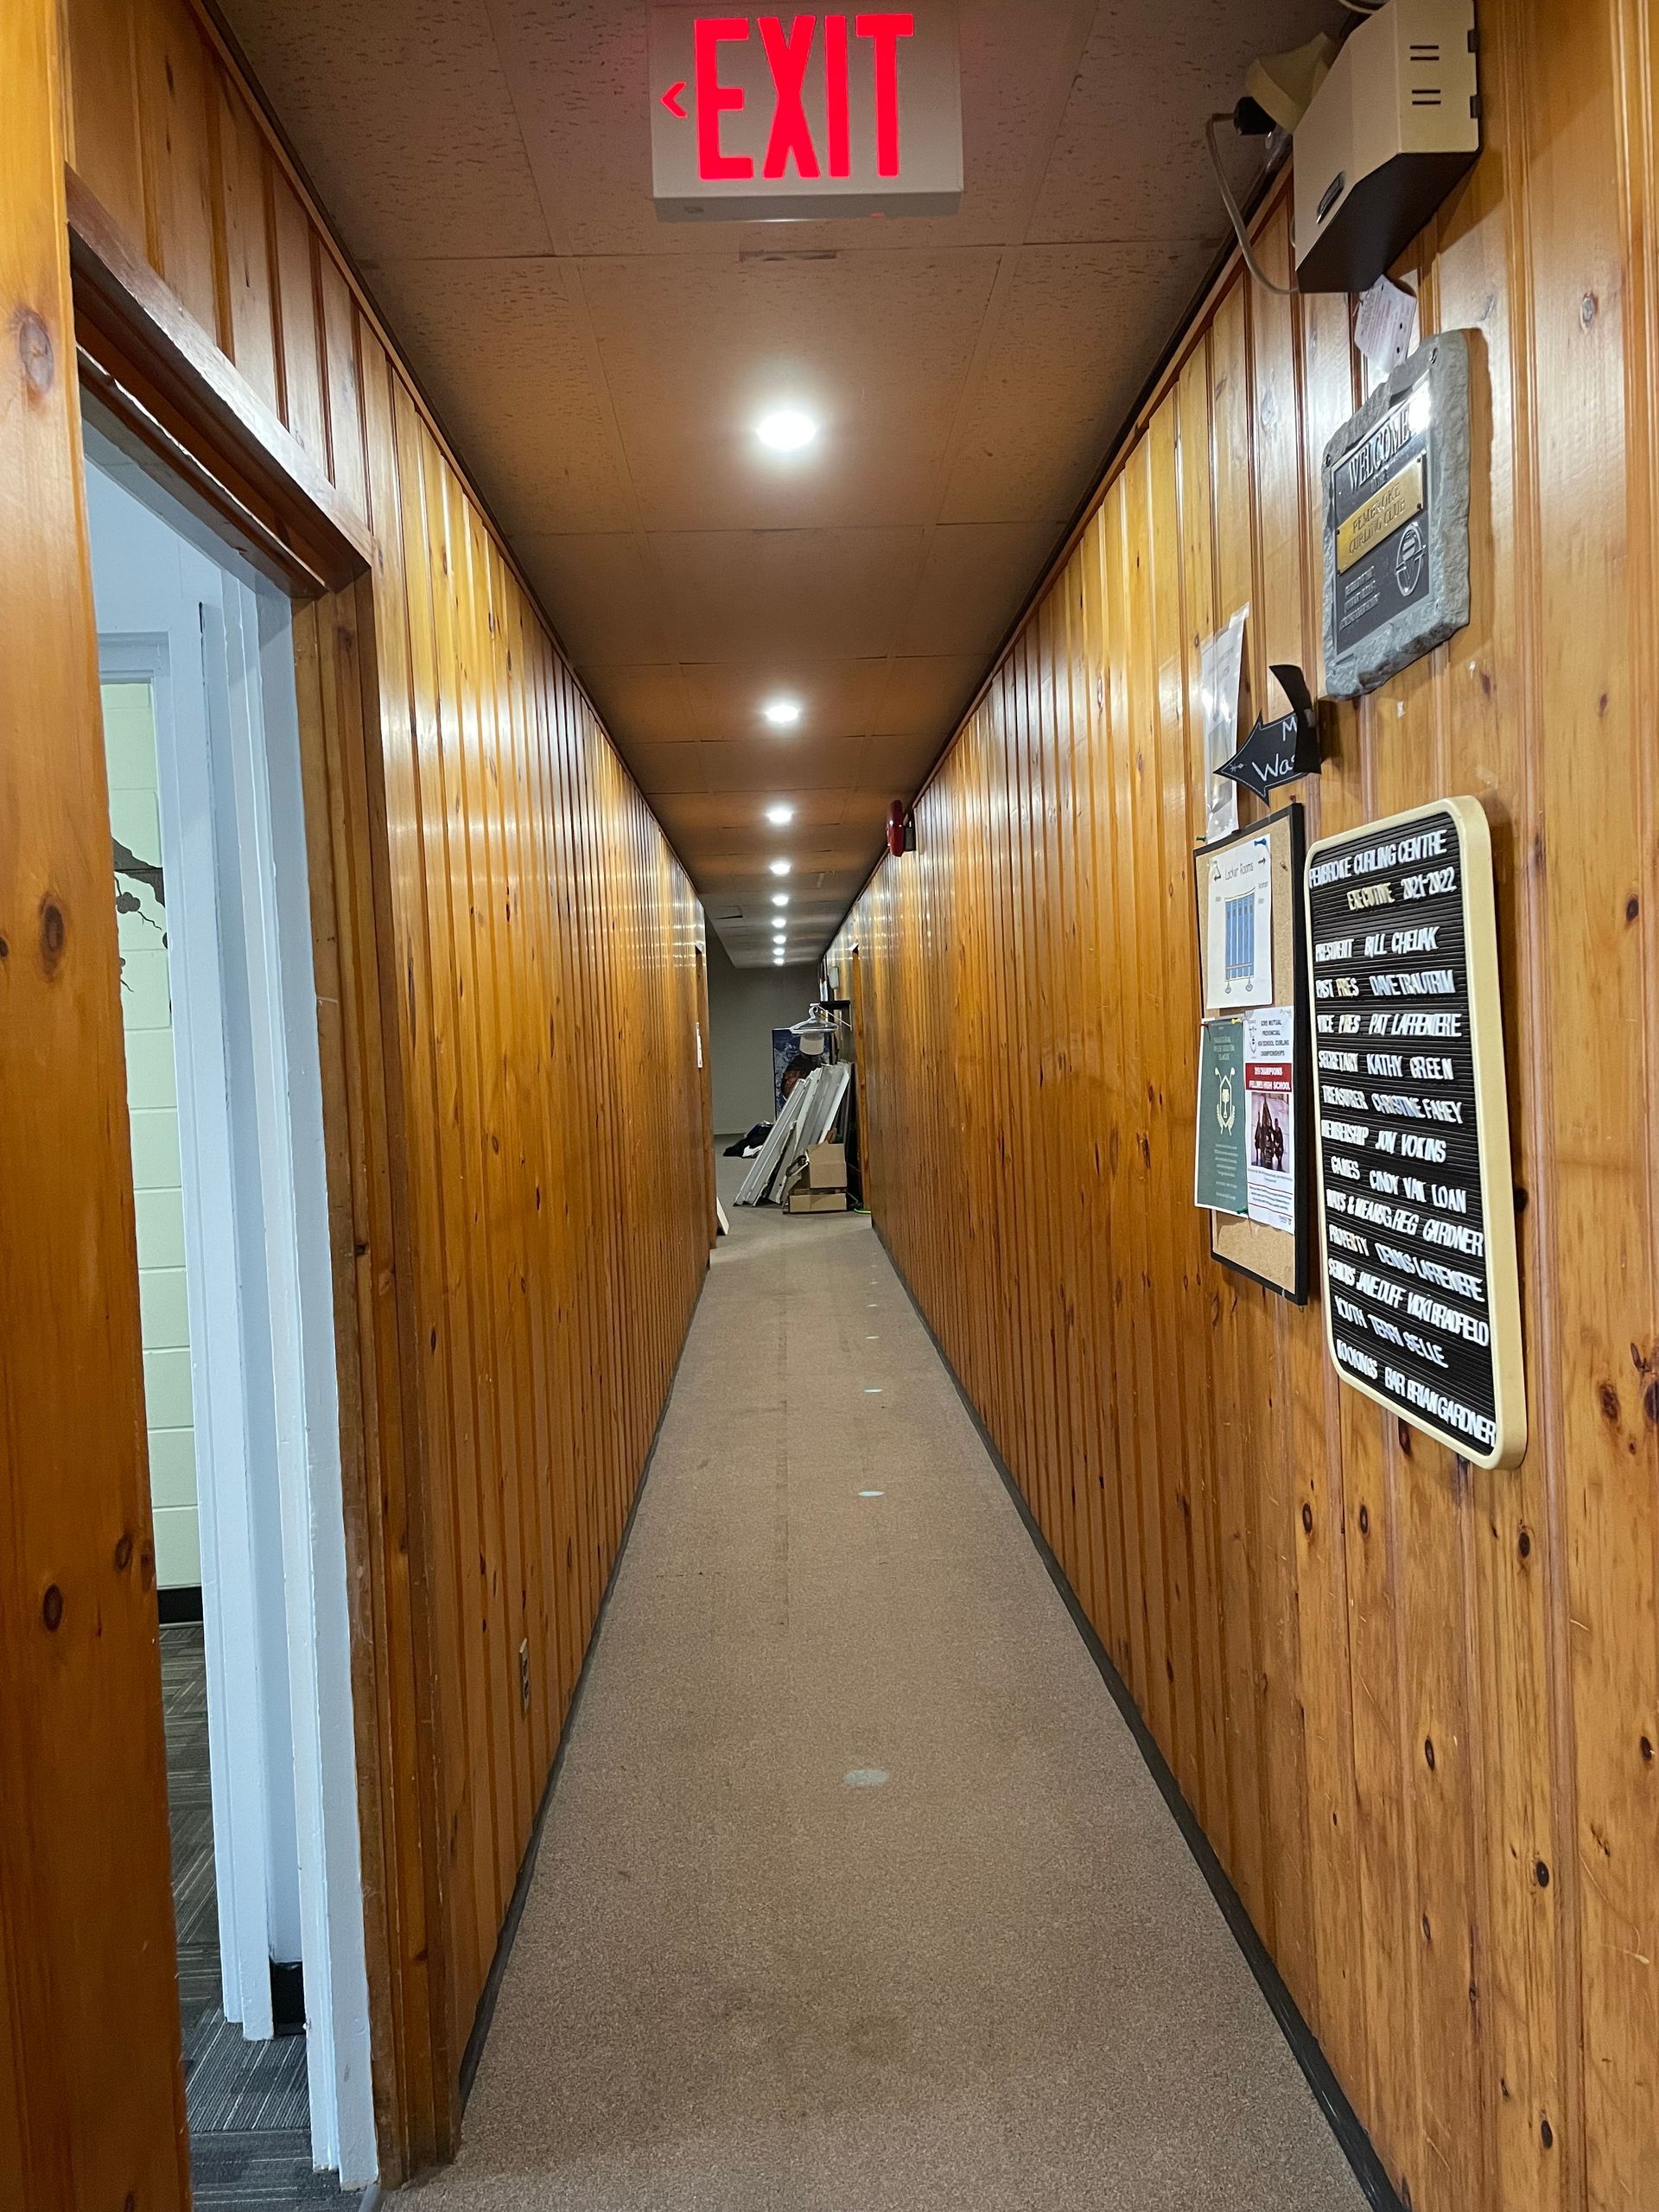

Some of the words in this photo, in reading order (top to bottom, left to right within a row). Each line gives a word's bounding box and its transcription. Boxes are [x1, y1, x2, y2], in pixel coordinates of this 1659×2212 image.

[694, 13, 914, 181] EXIT
[1349, 406, 1411, 493] WELCOME
[1349, 516, 1382, 554] CURLING
[1383, 498, 1406, 526] CLUB
[1352, 484, 1401, 533] PEMBROKE
[1309, 856, 1353, 889] PEMBROKE
[1353, 843, 1397, 875] CURLING
[1398, 830, 1447, 863] CENTRE
[1346, 882, 1395, 911] EXECUTIVE
[1401, 866, 1458, 900] 2021-2022
[1315, 938, 1354, 962] PRESIDENT
[1364, 933, 1387, 958] BILL
[1369, 975, 1401, 996] DAVE
[1317, 1014, 1335, 1033] VICE
[1369, 1013, 1392, 1035] PAT
[1319, 1051, 1358, 1072] SECRETARY
[1366, 1053, 1403, 1077] KATHY
[1409, 1056, 1454, 1080] GREEN
[1321, 1084, 1369, 1110] TREASURER
[1422, 1099, 1463, 1124] FAHEY
[1321, 1120, 1369, 1146] MEMBERSHIP
[1331, 1155, 1361, 1179] GAMES
[1369, 1170, 1400, 1195] CINDY
[1403, 1177, 1426, 1202] VAN
[1431, 1184, 1467, 1214] LOAN
[1329, 1224, 1370, 1256] PROPERTY
[1375, 1243, 1416, 1274] DENNIS
[1348, 1196, 1356, 1215] &
[1382, 1206, 1421, 1236] GREG
[1423, 1218, 1484, 1257] GARDNER
[1335, 1295, 1368, 1329] YOUTH
[1402, 1331, 1449, 1369] SELLE
[1379, 1280, 1407, 1309] DUFF
[1431, 1305, 1489, 1347] BRADFIELD
[1336, 1338, 1378, 1380] BOOKINGS
[1384, 1366, 1407, 1397] BAR
[1407, 1379, 1439, 1415] BRIAN
[1438, 1396, 1497, 1447] GARDNER
